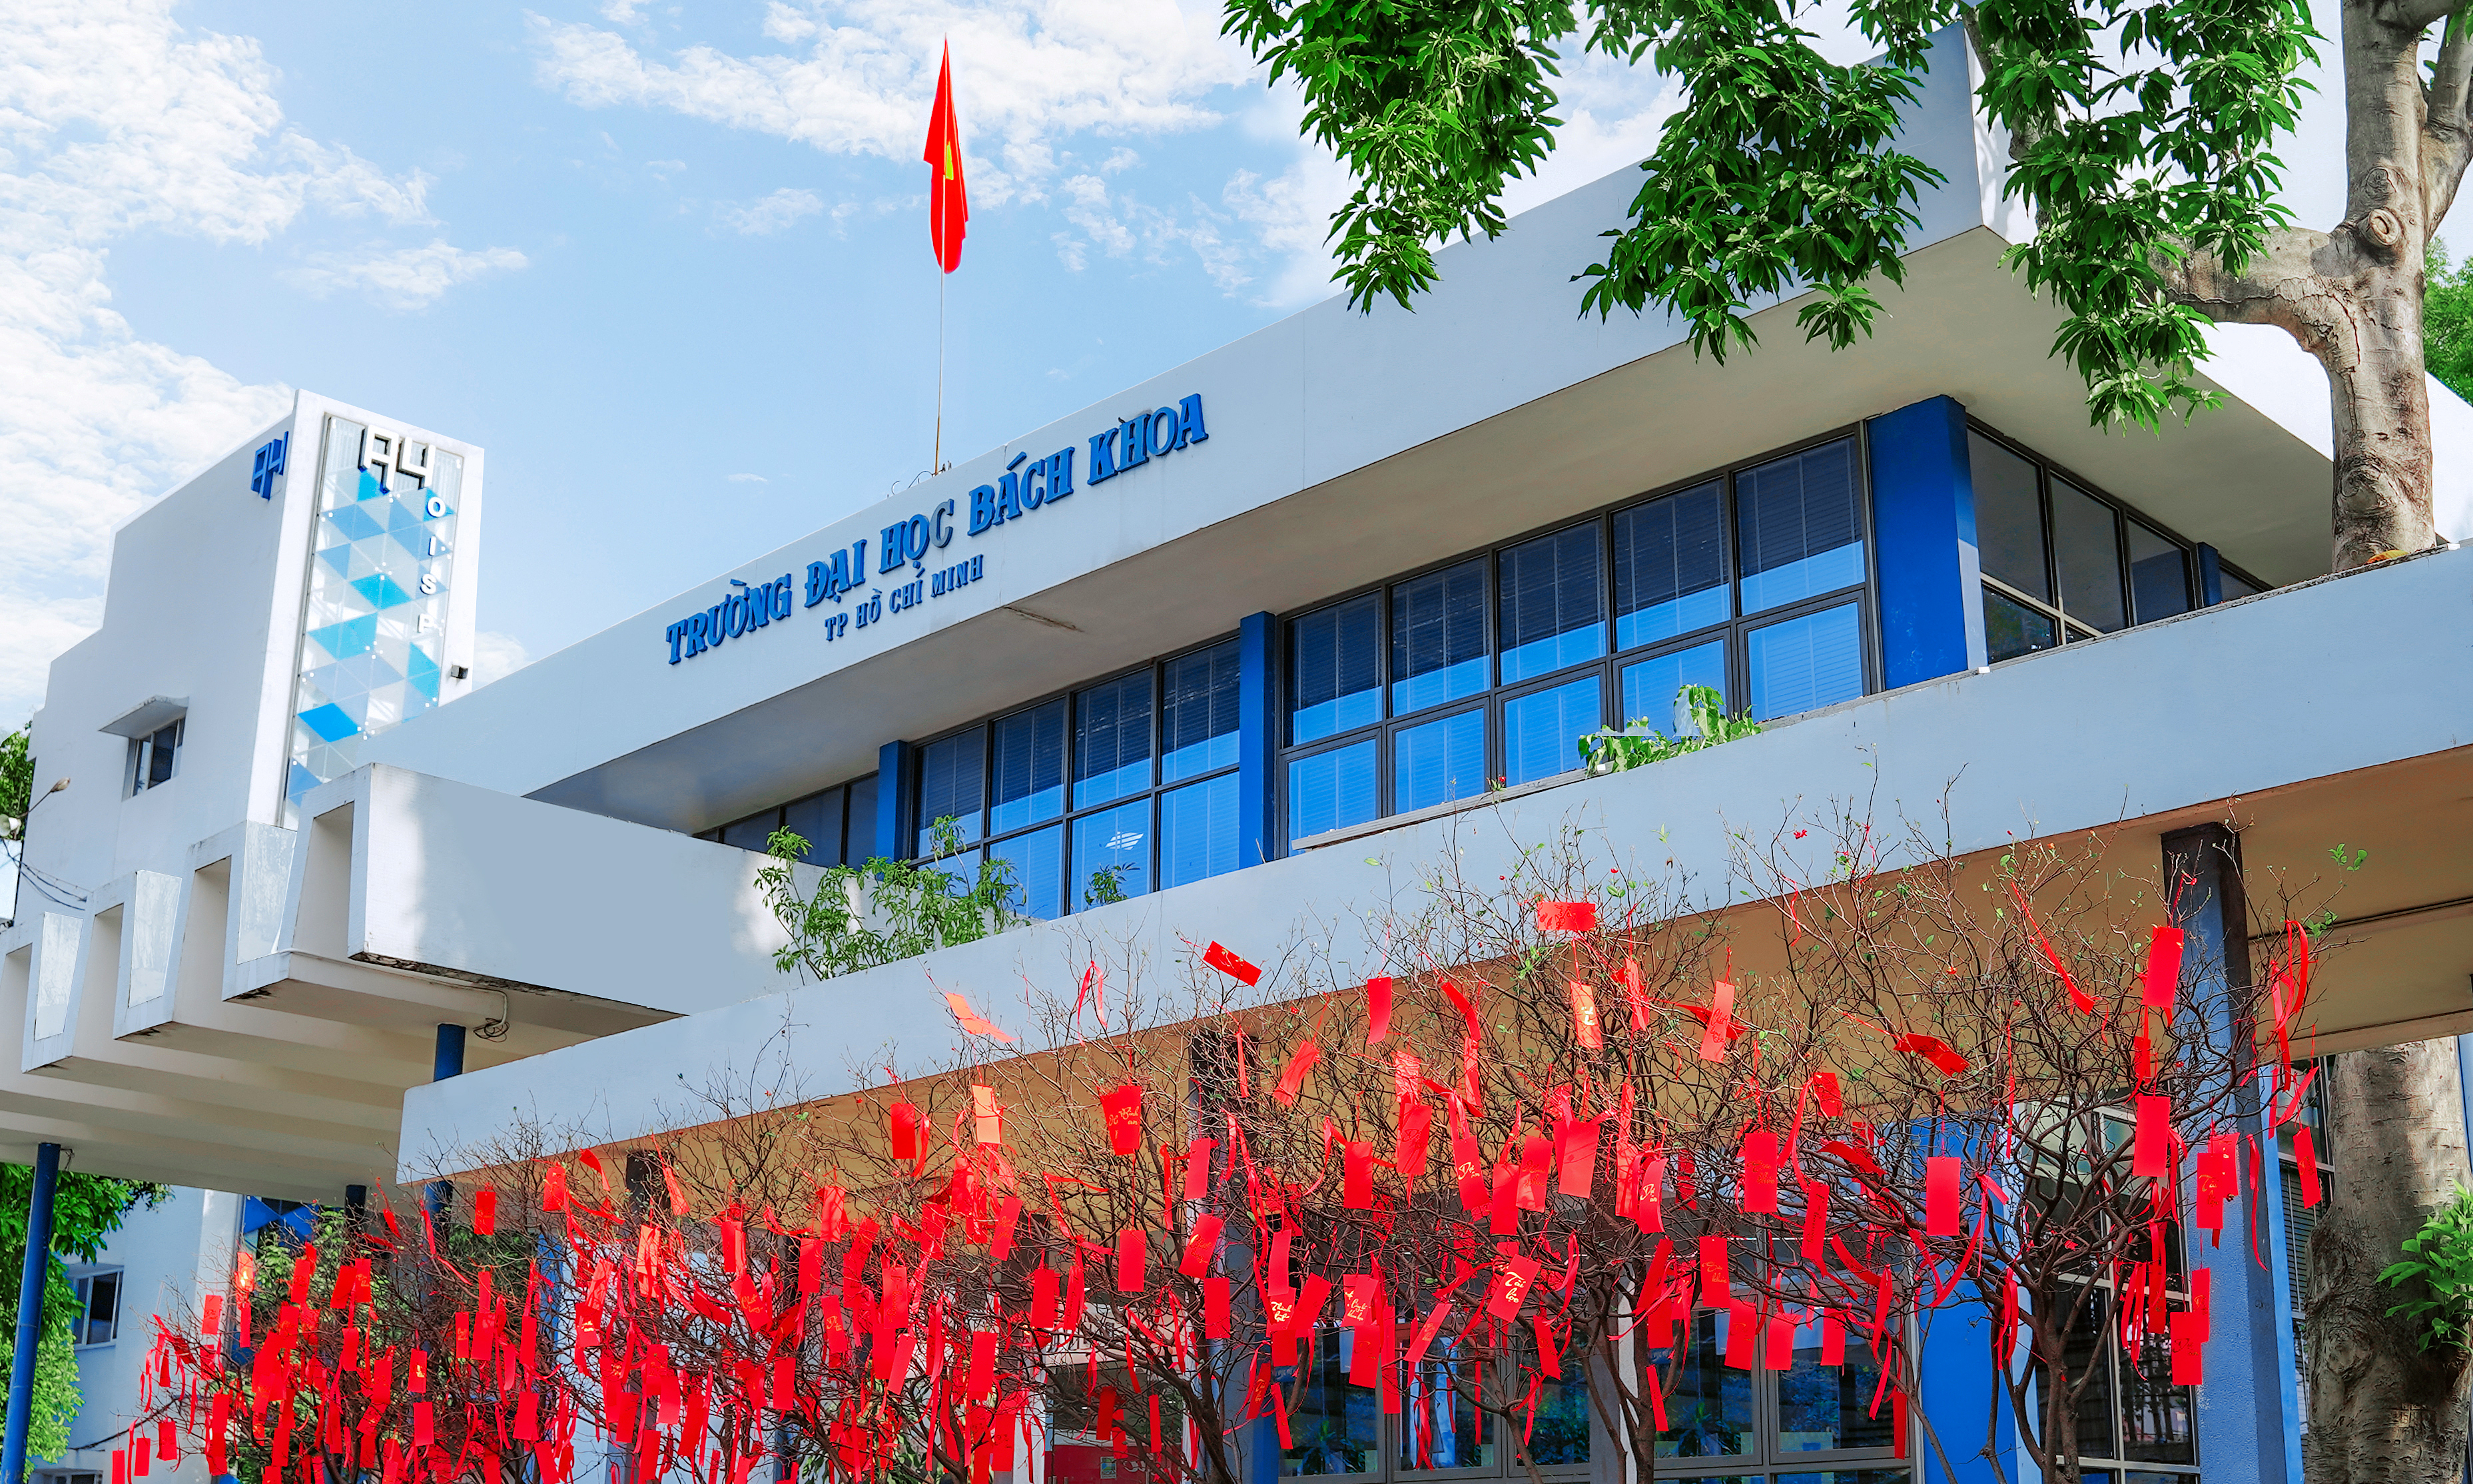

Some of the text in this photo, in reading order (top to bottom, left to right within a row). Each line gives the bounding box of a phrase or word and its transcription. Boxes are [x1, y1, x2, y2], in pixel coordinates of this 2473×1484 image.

[358, 424, 436, 494] A4
[666, 393, 1209, 665] TRƯỜNG ĐẠI HỌC BÁCH KHOA
[825, 554, 983, 641] TP HỒ CHÍ MINH
[1505, 1272, 1526, 1288] Tài
[1506, 1288, 1519, 1303] lộc
